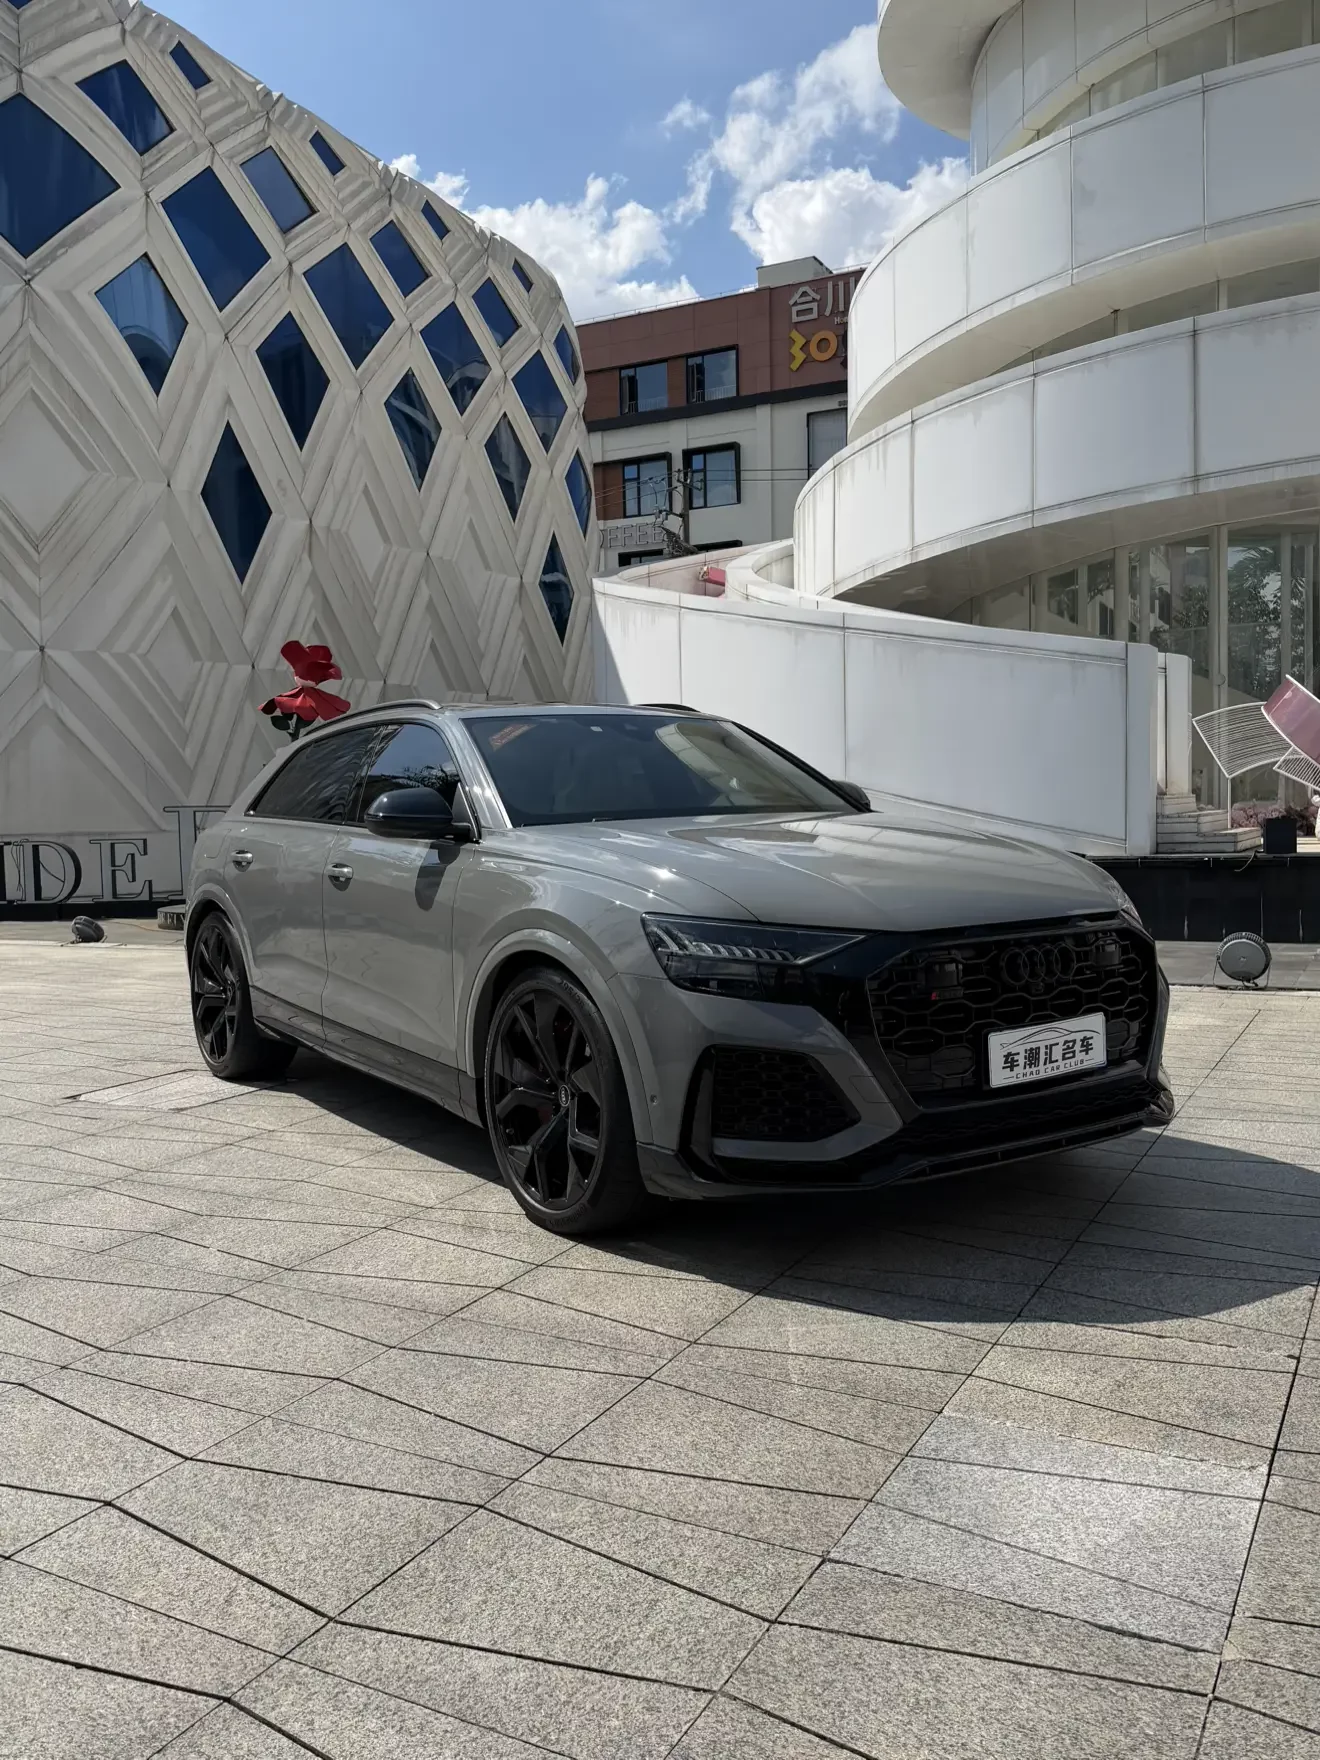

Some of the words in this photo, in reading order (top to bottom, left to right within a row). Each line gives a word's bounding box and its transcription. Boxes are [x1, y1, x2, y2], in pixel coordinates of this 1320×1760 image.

[1001, 1035, 1094, 1072] 车潮汇名车
[1015, 1068, 1040, 1080] CHAO
[1044, 1064, 1061, 1073] CAR
[1063, 1059, 1085, 1070] CLUB
